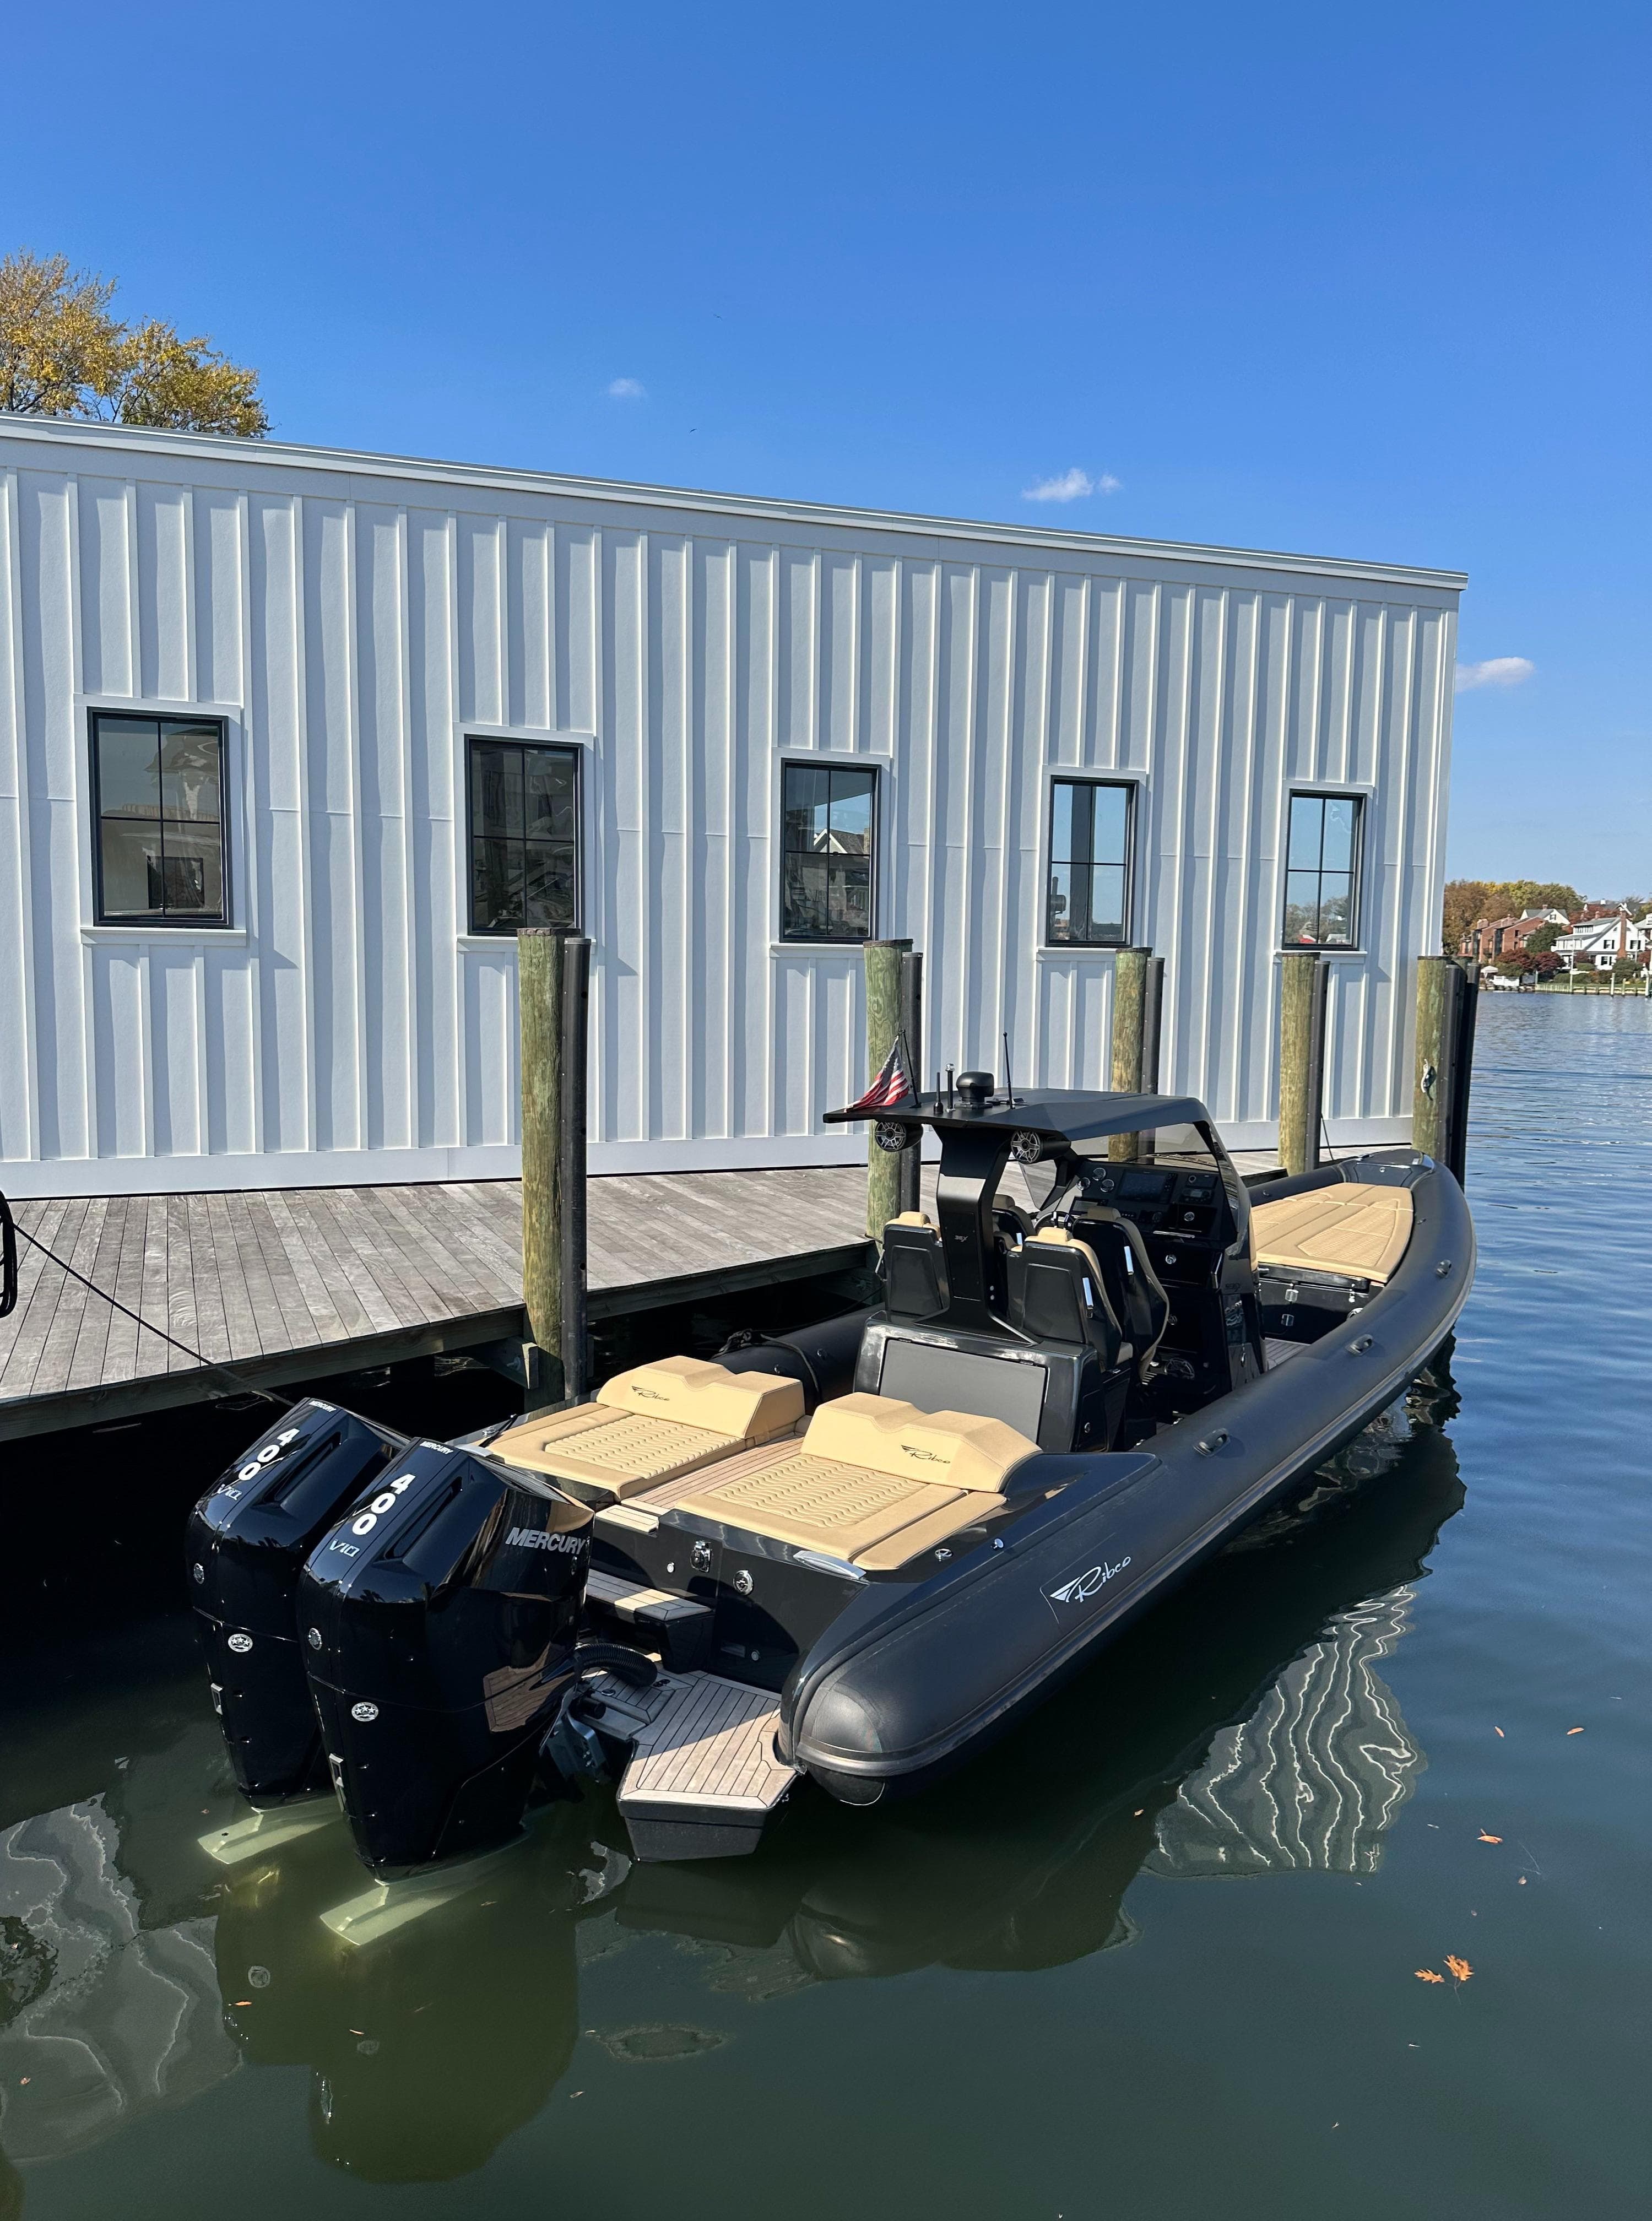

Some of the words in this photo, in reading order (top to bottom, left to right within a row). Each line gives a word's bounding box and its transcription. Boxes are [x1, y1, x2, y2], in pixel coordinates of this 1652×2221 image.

[633, 1390, 670, 1401] Ribco
[308, 1401, 337, 1412] MERCURY
[238, 1428, 300, 1481] 400
[419, 1441, 454, 1455] MERCURY
[904, 1449, 951, 1464] Ribco
[352, 1474, 416, 1535] 400
[329, 1539, 360, 1557] V10
[505, 1527, 586, 1555] MERCURY
[1065, 1556, 1131, 1603] Ribco
